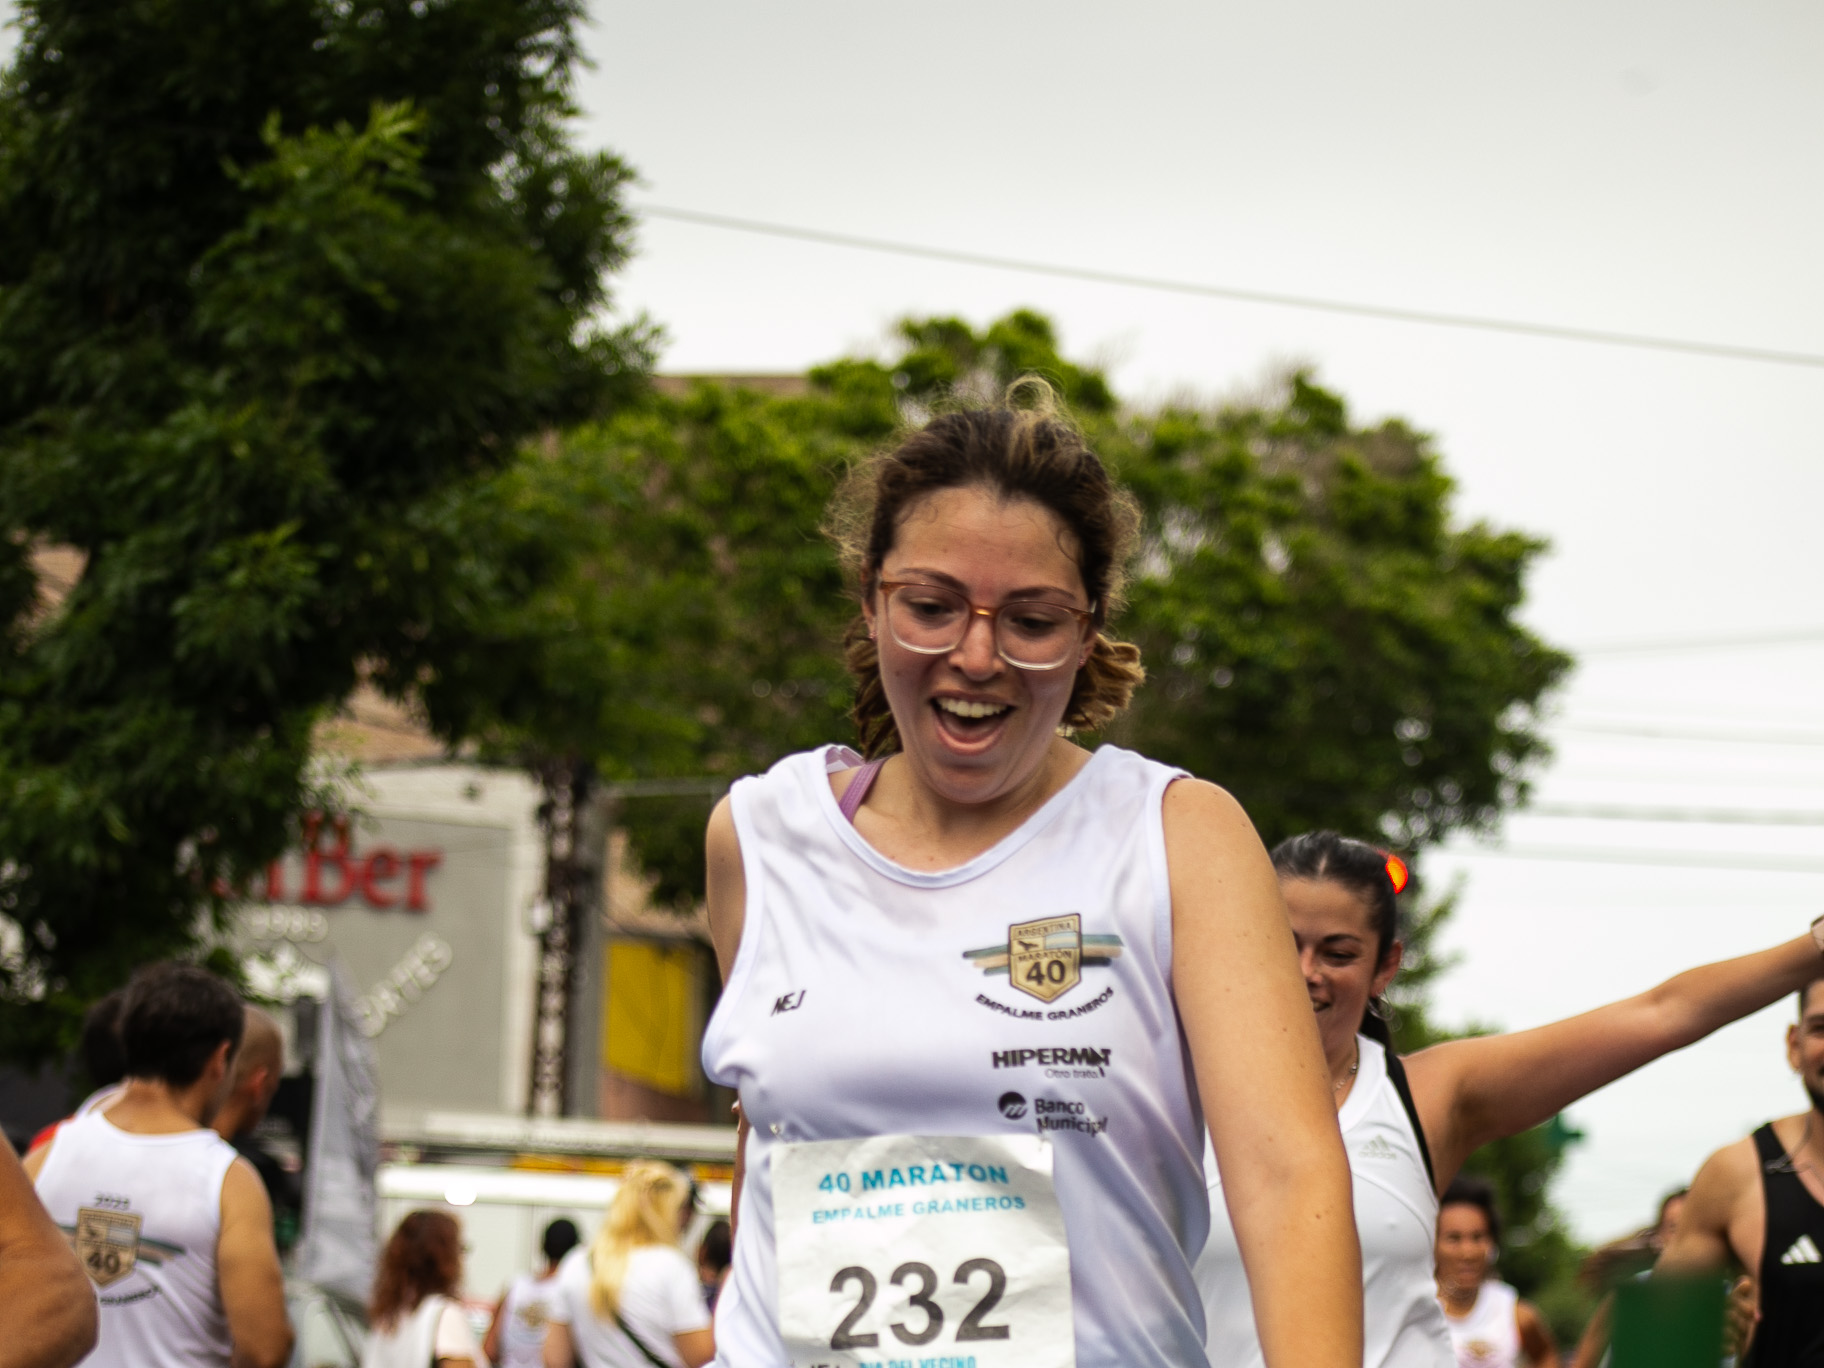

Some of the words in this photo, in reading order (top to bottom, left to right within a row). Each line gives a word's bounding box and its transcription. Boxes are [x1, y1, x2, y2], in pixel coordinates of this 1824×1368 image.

[1026, 960, 1066, 986] 40
[975, 993, 1043, 1021] EMPALME
[1047, 986, 1114, 1021] GRANEROS
[1034, 1098, 1085, 1115] Banco
[818, 1173, 850, 1193] 40
[861, 1162, 1009, 1191] MARATON
[812, 1203, 905, 1225] EMPALME
[912, 1195, 1026, 1216] GRANEROS
[87, 1251, 121, 1275] 40
[829, 1257, 1011, 1350] 232
